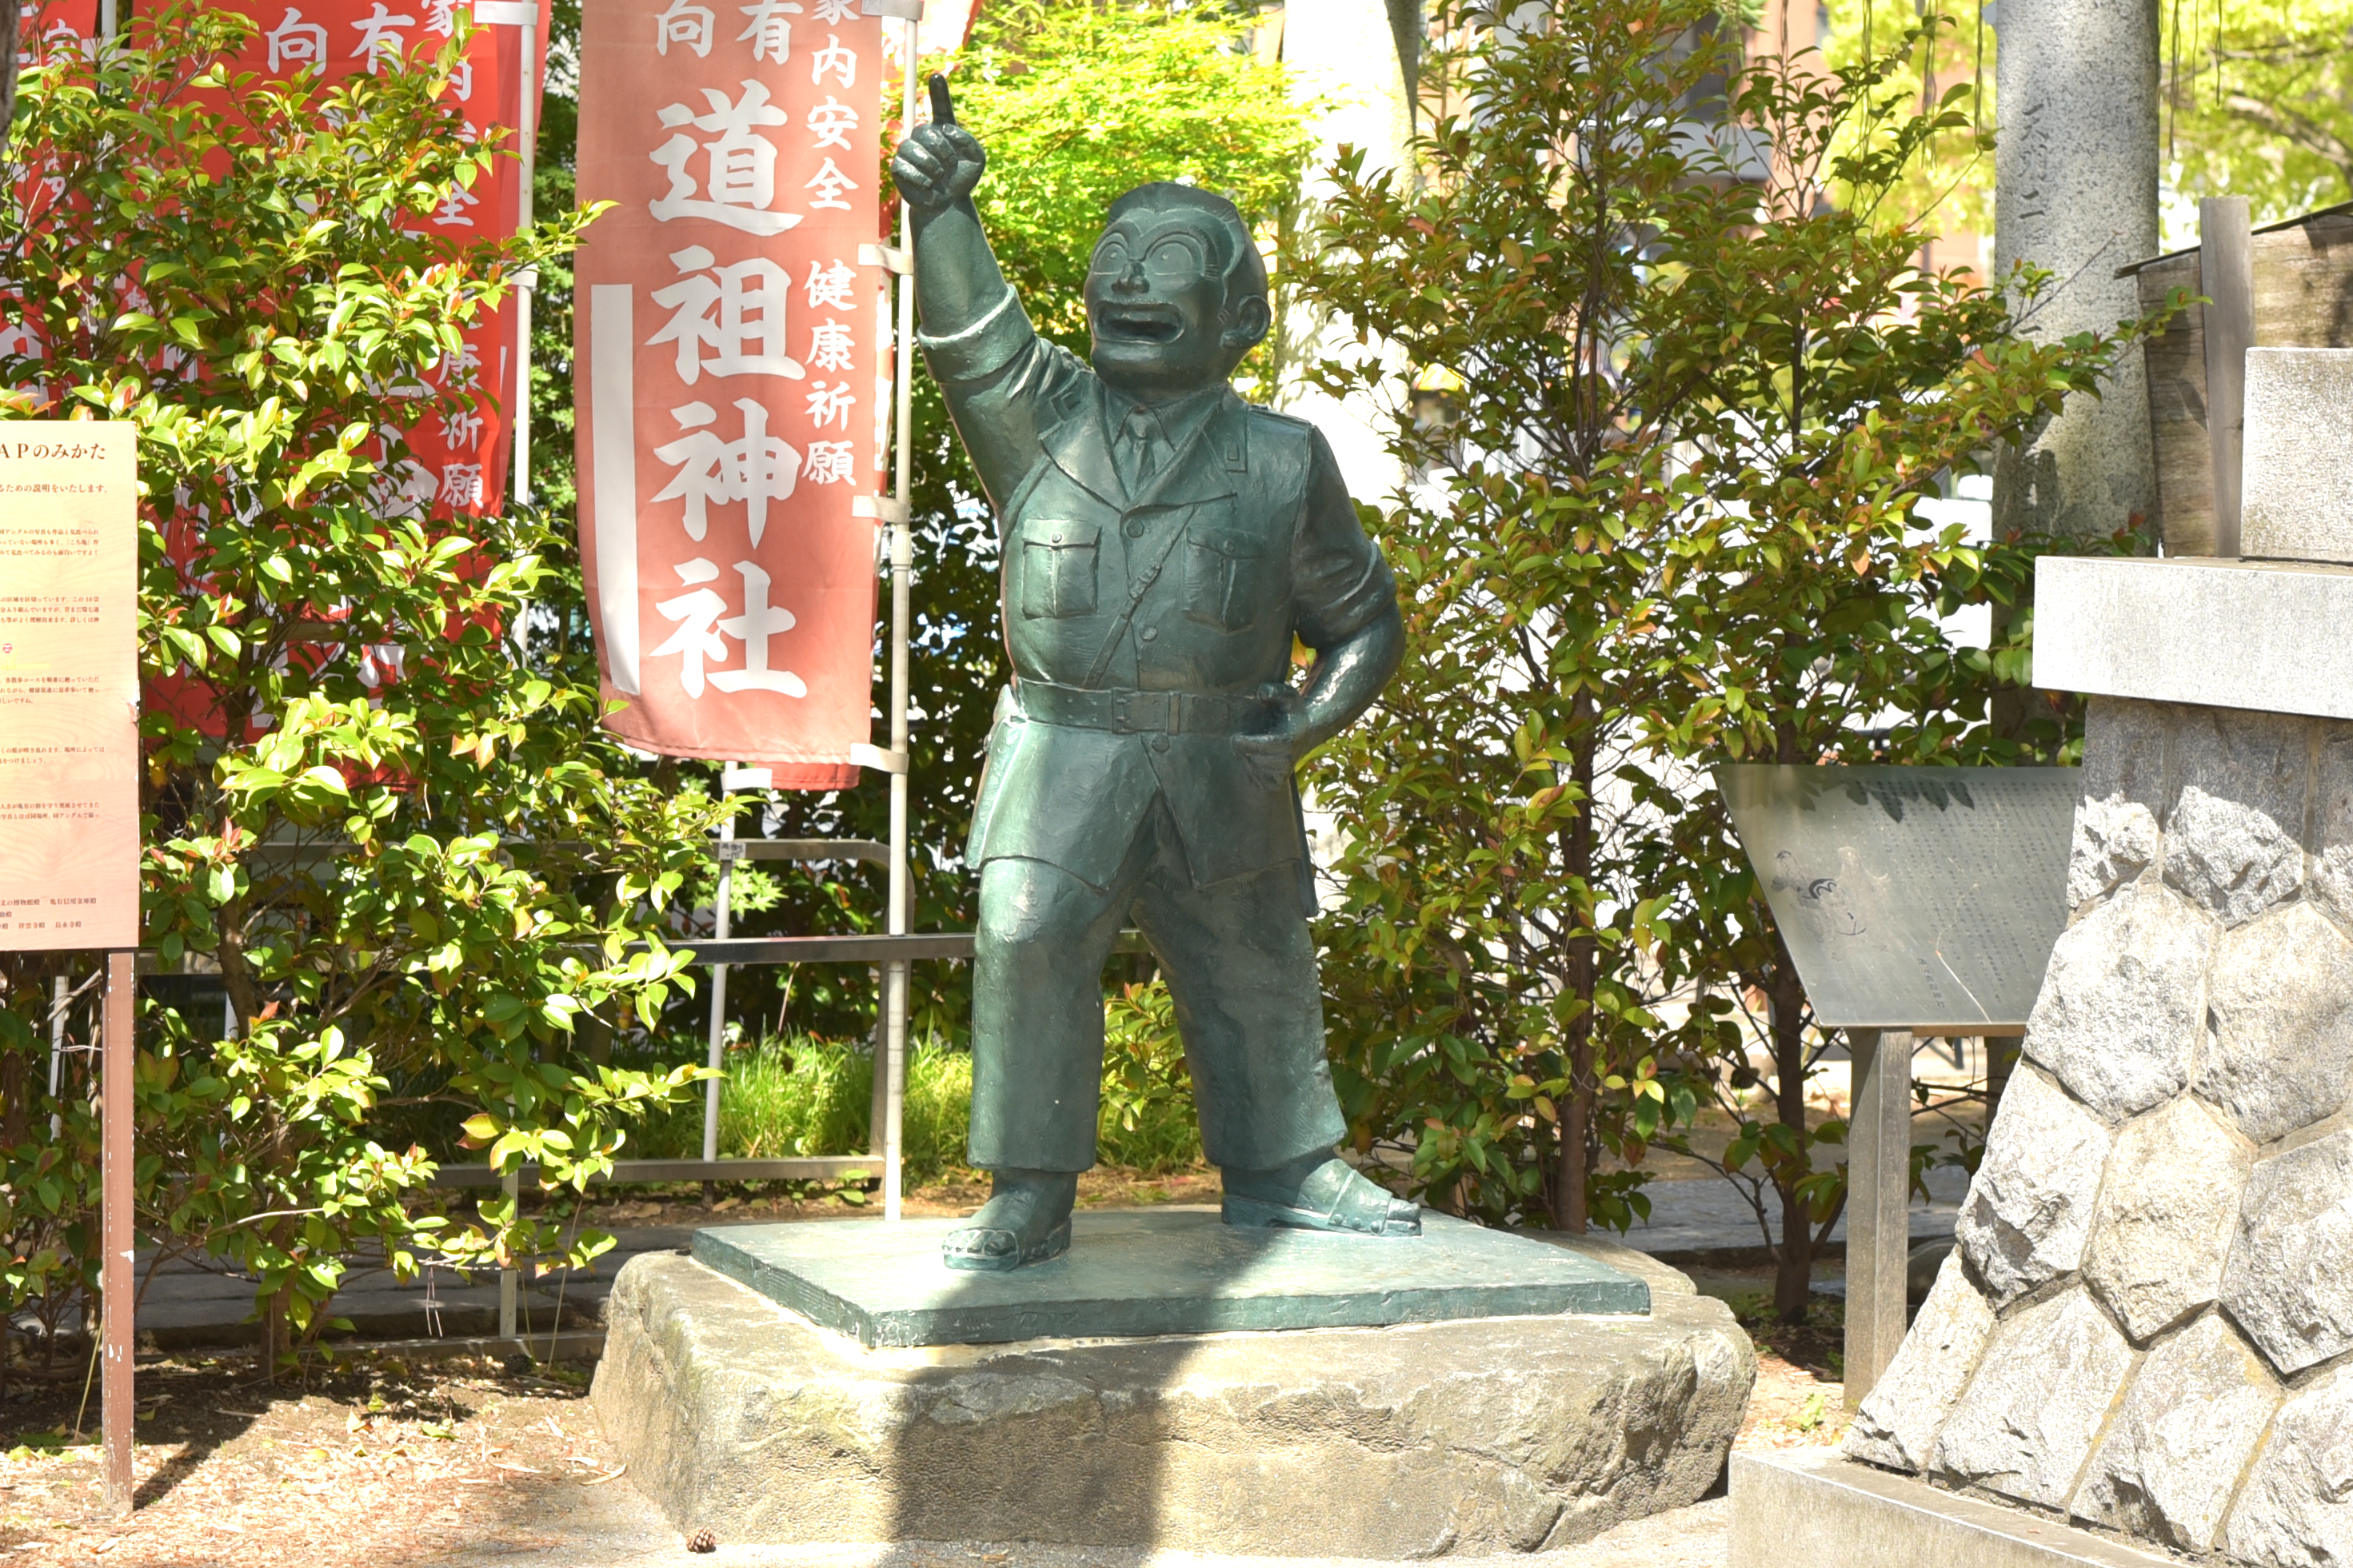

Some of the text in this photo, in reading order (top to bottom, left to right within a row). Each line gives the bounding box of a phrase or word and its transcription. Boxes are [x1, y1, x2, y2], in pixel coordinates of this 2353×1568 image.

[264, 7, 328, 76] 向
[654, 0, 716, 58] 向
[736, 0, 804, 65] 有
[644, 78, 808, 699] 道祖神社
[801, 259, 858, 486] 健康祈願
